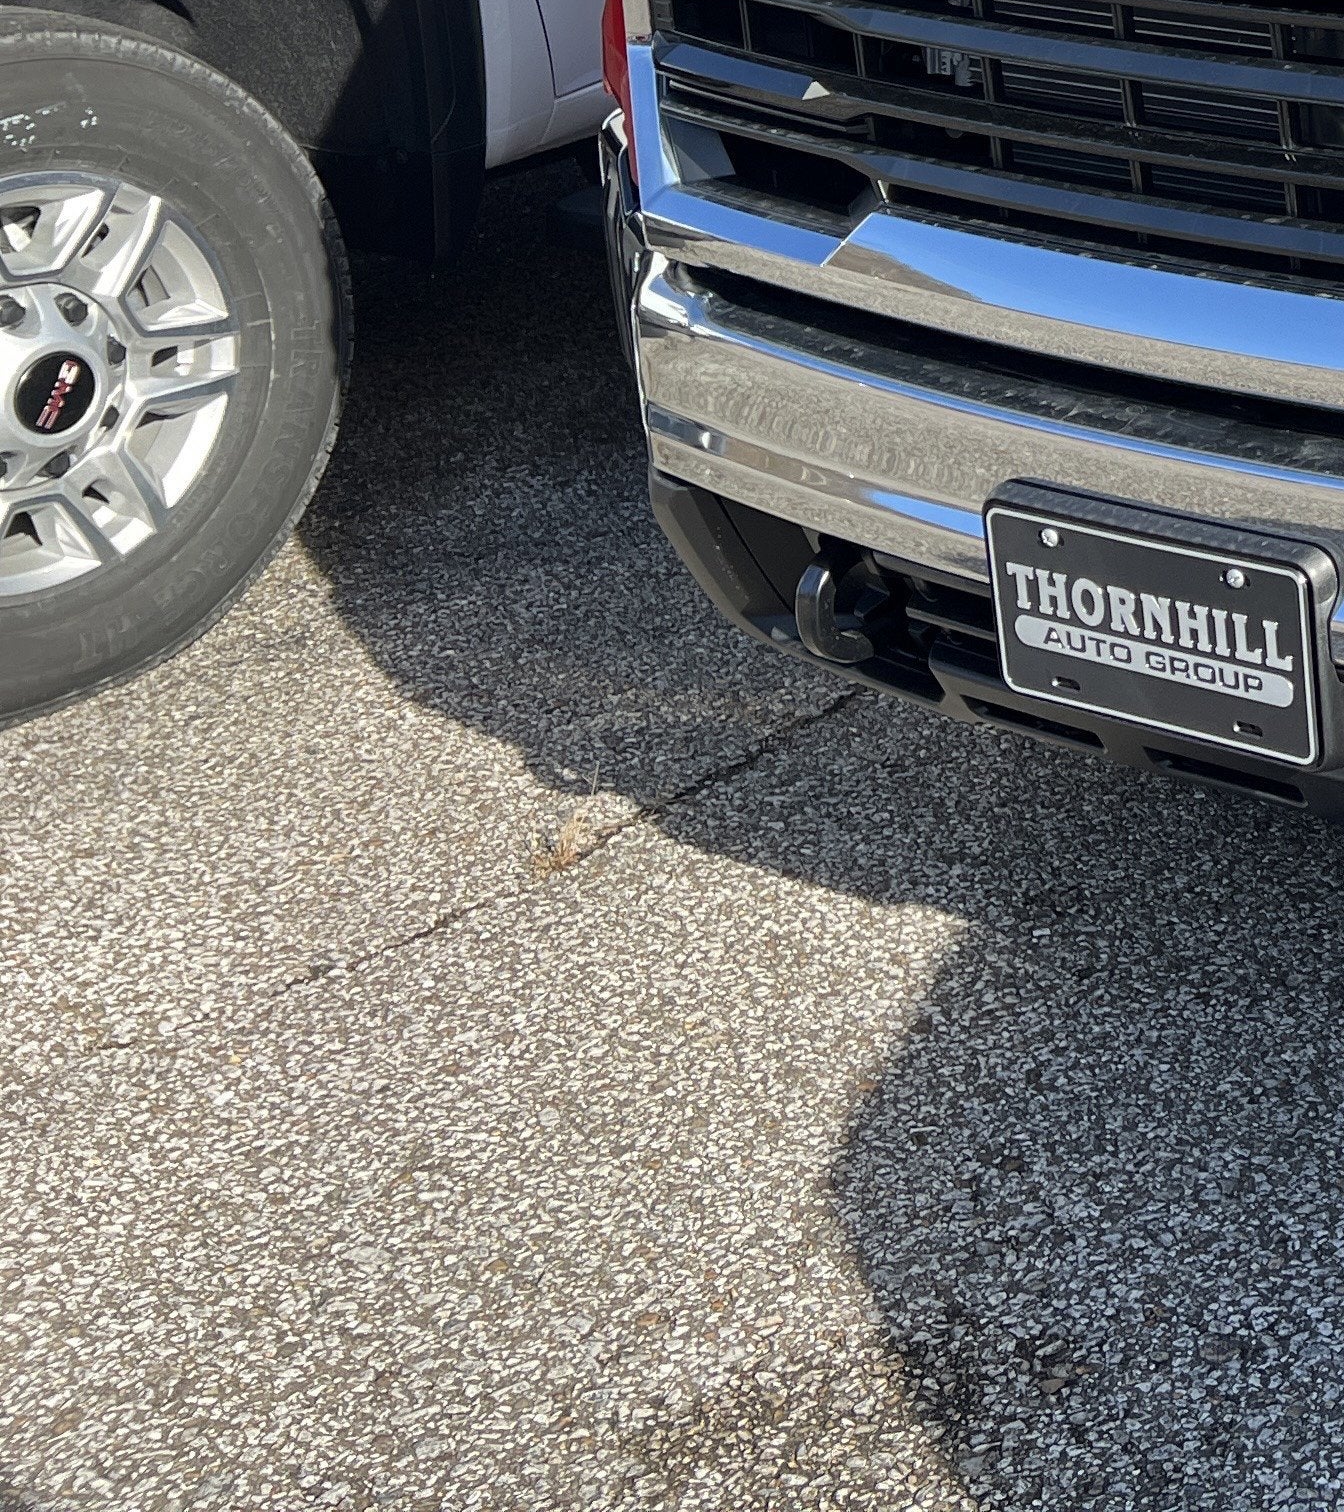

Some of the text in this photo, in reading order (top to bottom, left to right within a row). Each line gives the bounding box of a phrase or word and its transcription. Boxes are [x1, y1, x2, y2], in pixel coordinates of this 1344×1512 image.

[1006, 562, 1293, 672] THORNHILL
[1043, 626, 1264, 693] AUTO GROUP
